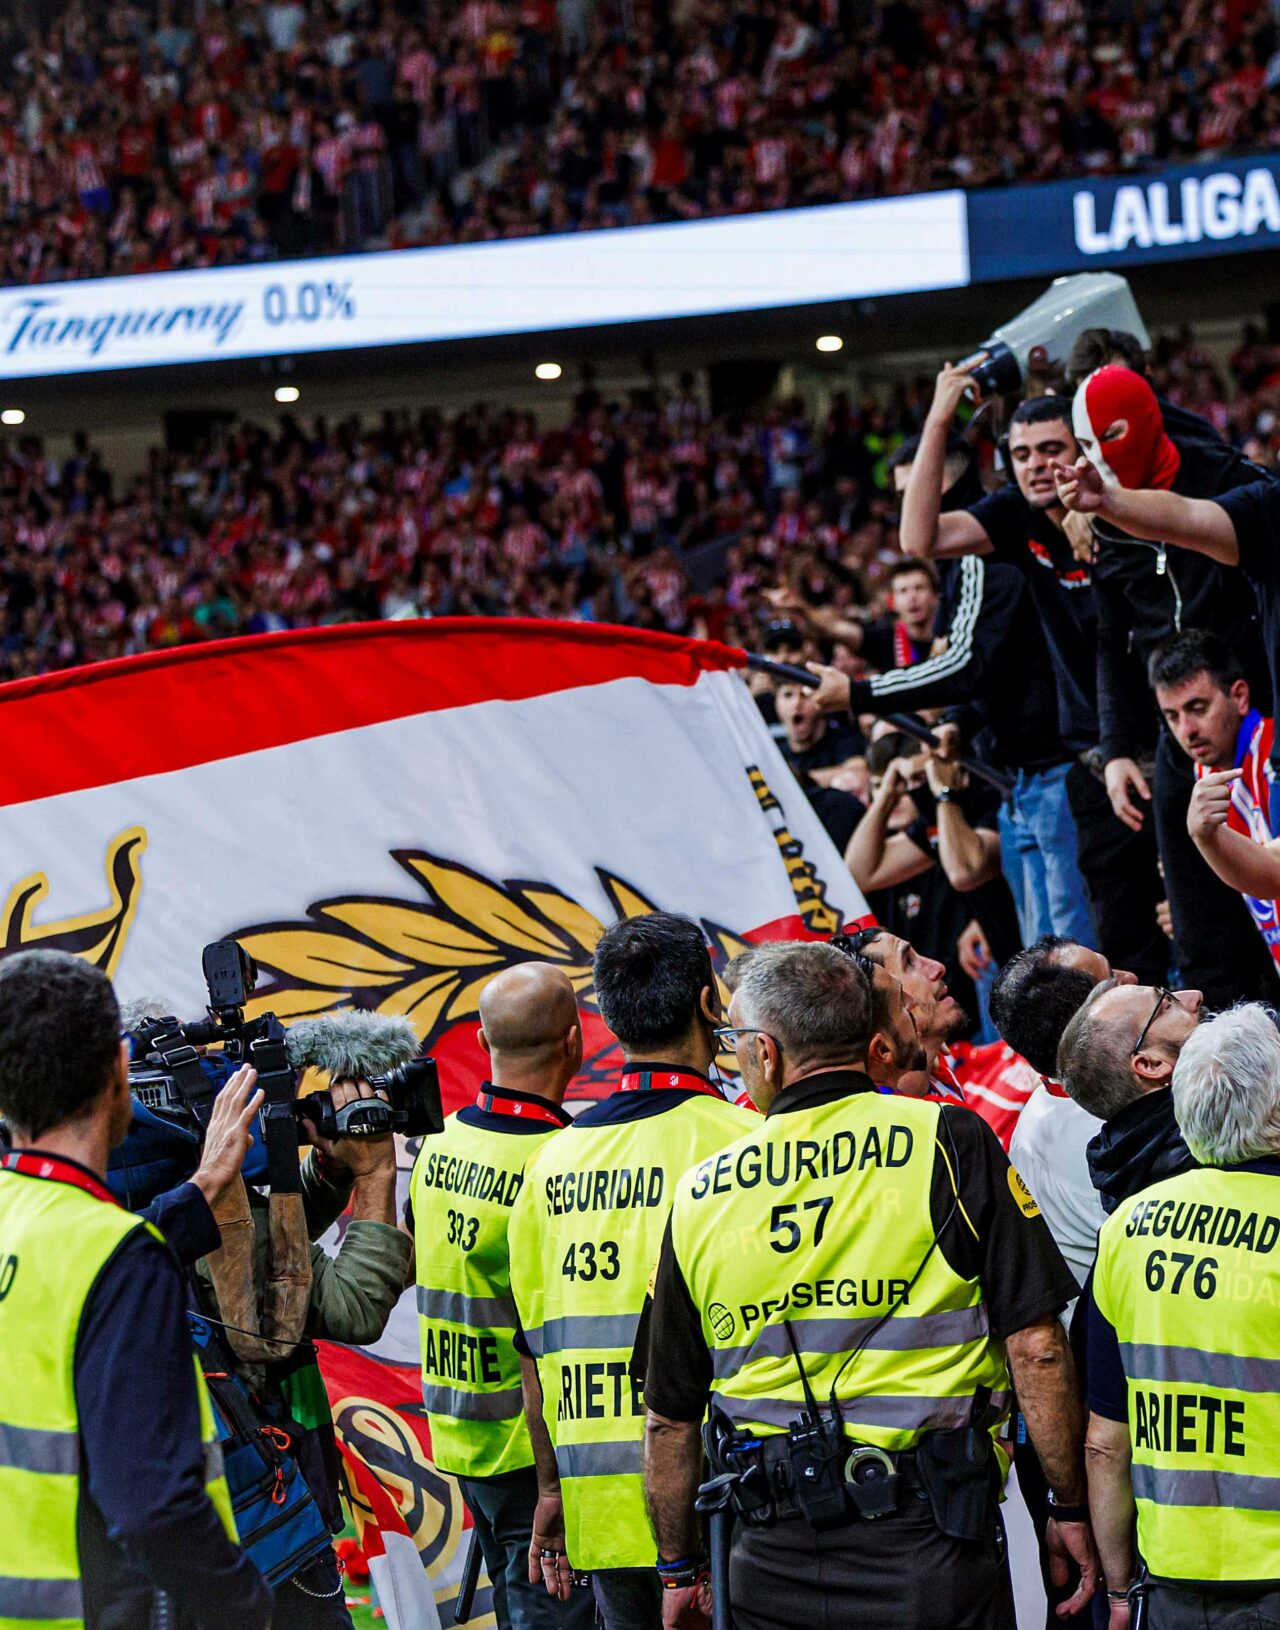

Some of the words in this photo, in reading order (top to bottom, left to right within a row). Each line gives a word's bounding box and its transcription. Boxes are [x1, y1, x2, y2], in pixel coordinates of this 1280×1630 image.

[2, 299, 245, 356] Tanqueray
[263, 278, 358, 327] 0.0%
[425, 1152, 524, 1208] SEGURIDAD
[691, 1124, 914, 1200] SEGURIDAD
[545, 1167, 665, 1217] SEGURIDAD
[769, 1196, 834, 1254] 57
[562, 1240, 621, 1282] 433
[1145, 1249, 1219, 1300] 676
[425, 1328, 502, 1384] ARIETE
[1135, 1391, 1246, 1457] ARIETE
